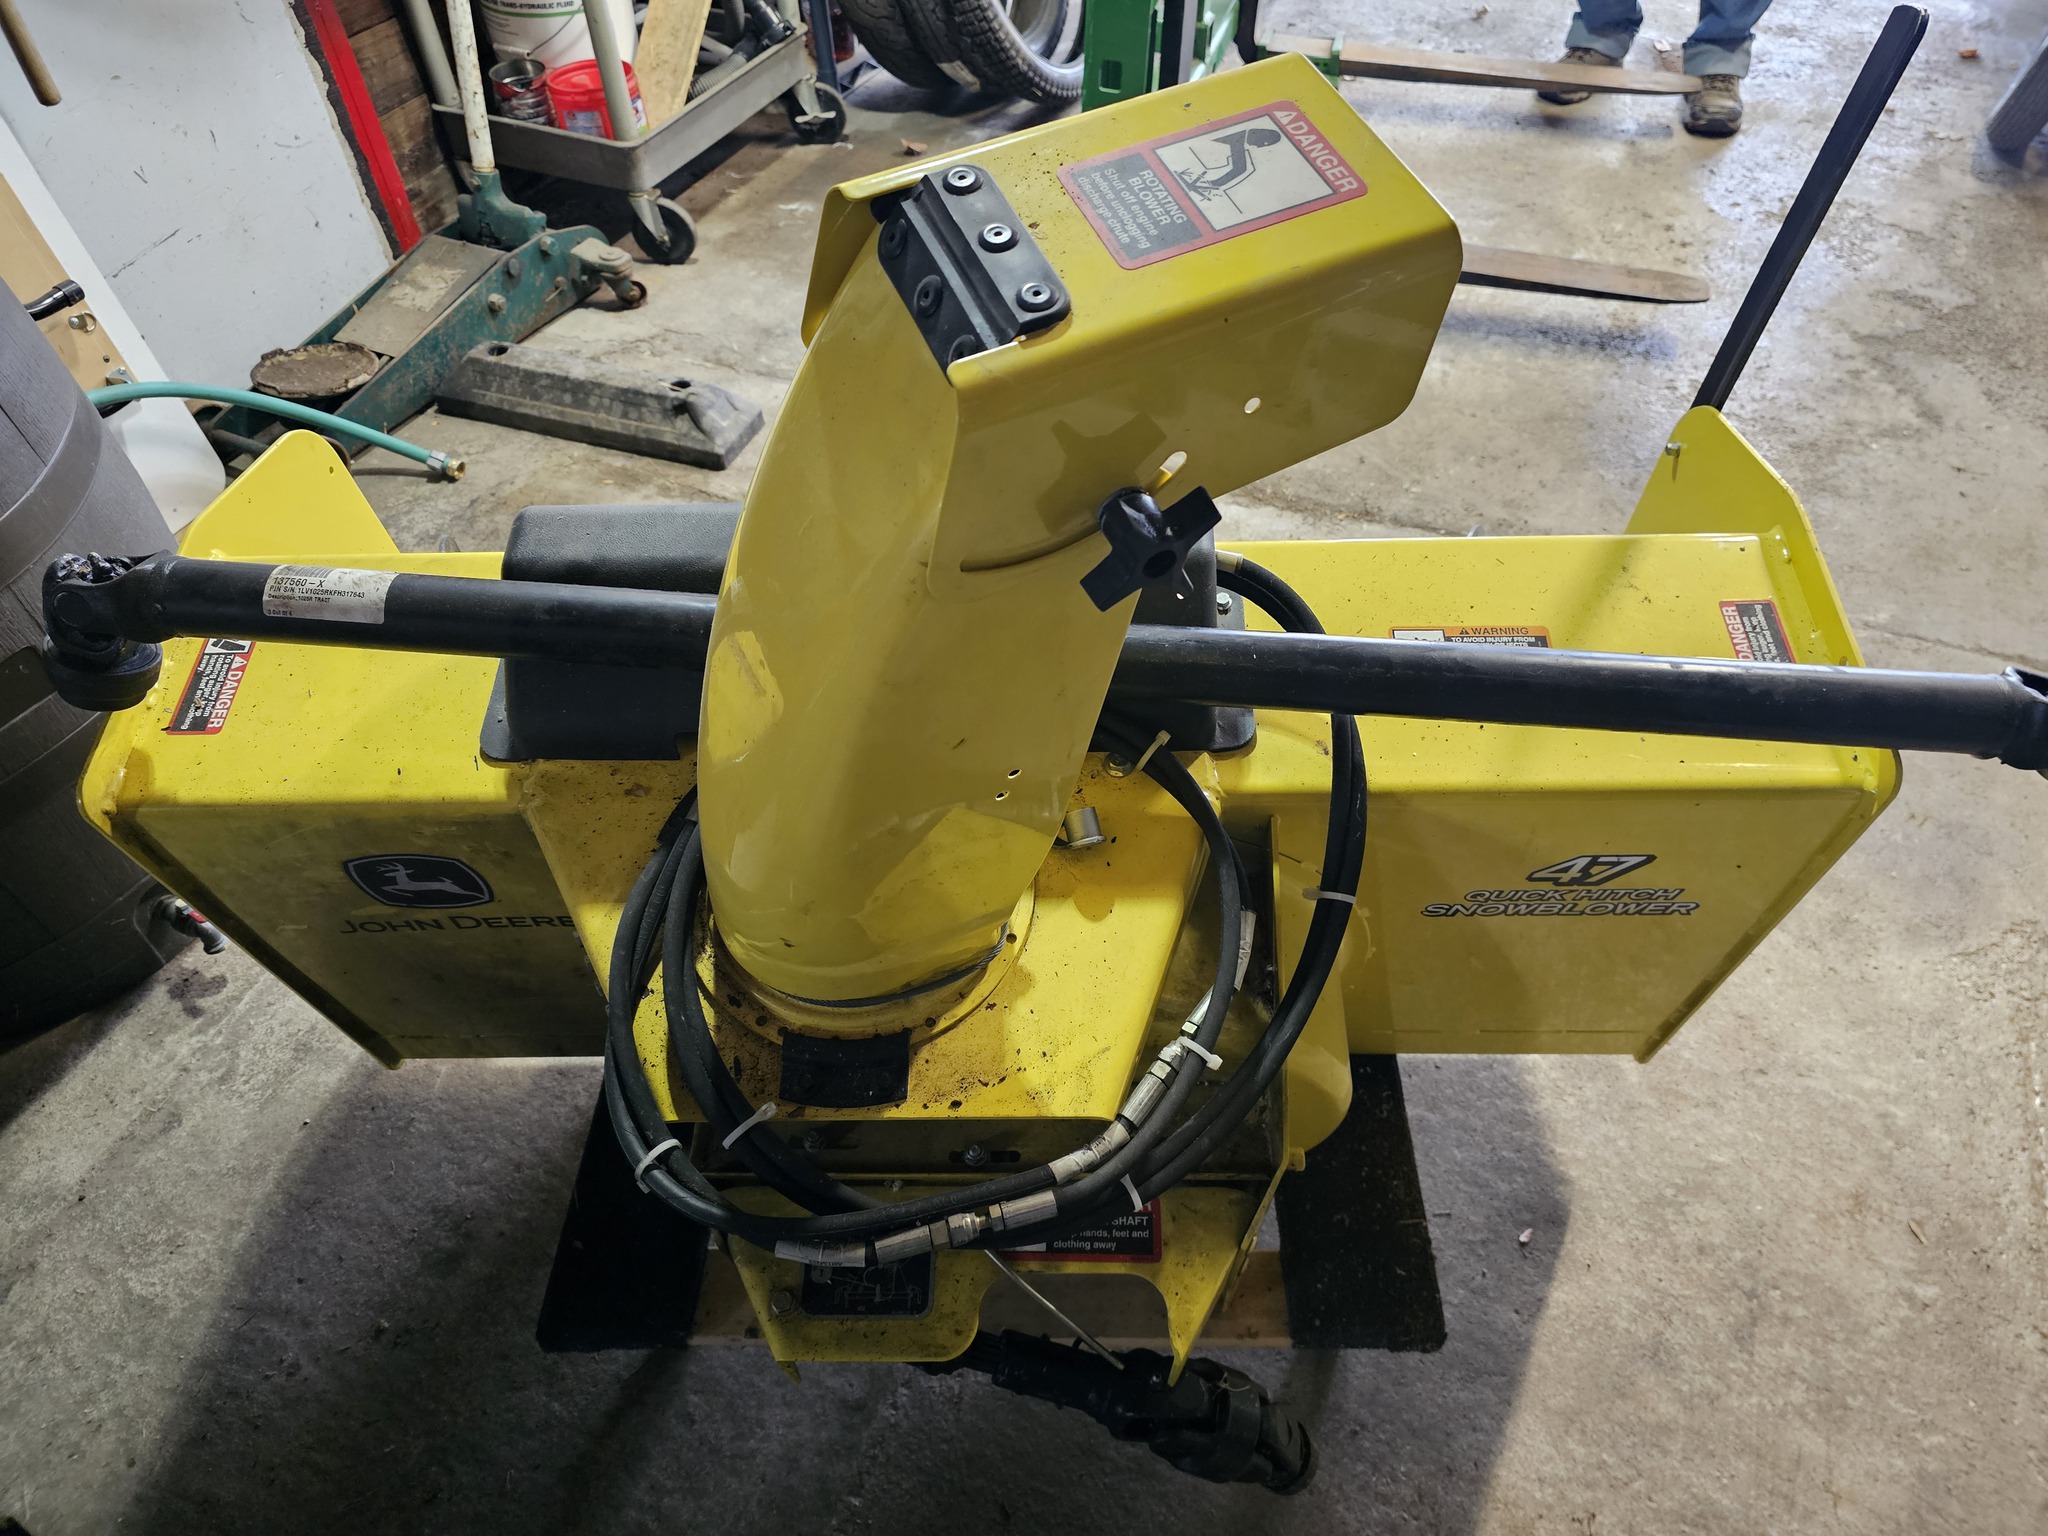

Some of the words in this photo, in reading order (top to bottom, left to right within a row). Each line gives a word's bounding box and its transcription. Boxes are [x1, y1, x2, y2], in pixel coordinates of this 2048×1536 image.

[556, 0, 574, 8] FLUID
[1285, 121, 1358, 193] DANGER
[1104, 168, 1126, 190] Shut
[1121, 190, 1137, 204] off
[1131, 205, 1159, 236] engine
[1128, 177, 1172, 225] BLOWER
[1140, 169, 1187, 224] ROTATING
[1077, 176, 1112, 218] discharge
[1107, 218, 1130, 244] chute
[1091, 172, 1115, 200] before
[1111, 200, 1151, 249] unclogging
[1742, 616, 1752, 632] from
[1754, 604, 1768, 630] clothing
[1471, 627, 1529, 635] WARNING
[1722, 606, 1754, 660] DANGER
[1762, 630, 1773, 643] and
[1748, 632, 1760, 651] injury
[203, 654, 218, 676] hands,
[209, 654, 225, 679] rotating
[224, 654, 234, 663] To
[218, 664, 229, 681] avoid
[198, 676, 210, 689] feet
[209, 681, 223, 700] injury
[203, 701, 215, 716] from
[207, 671, 243, 728] DANGER
[1525, 854, 1657, 886] 47
[1464, 888, 1572, 901] QUICK
[1573, 888, 1685, 901] HITCH
[1420, 902, 1700, 917] SNOWBLOWER
[340, 918, 446, 934] JOHN
[448, 915, 576, 930] DEERE
[1112, 1229, 1130, 1237] feet
[1131, 1229, 1149, 1238] and
[1053, 1240, 1091, 1250] clothing
[1093, 1241, 1117, 1251] away
